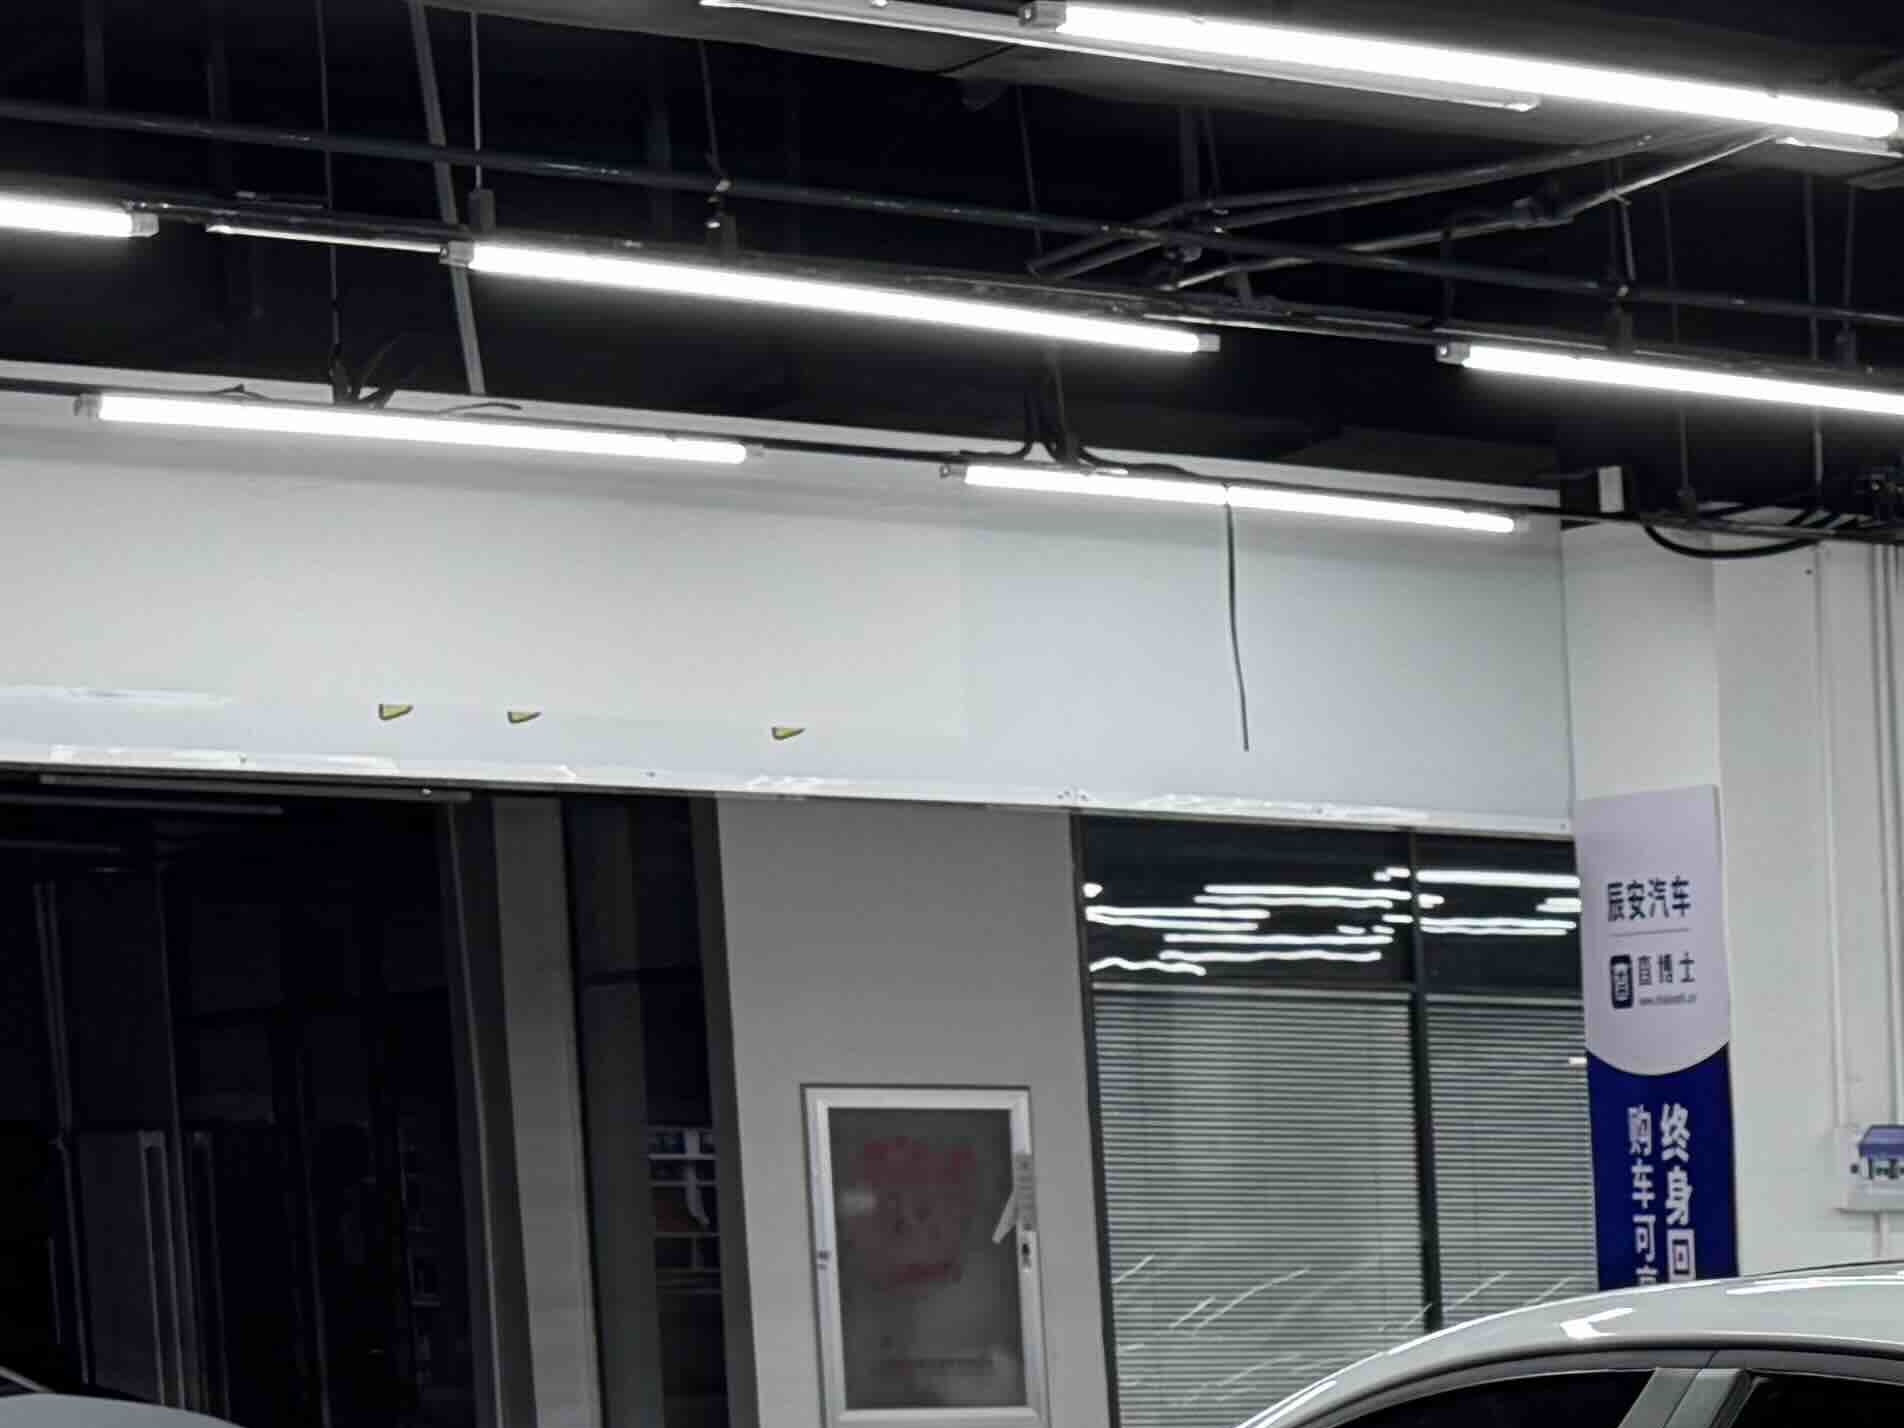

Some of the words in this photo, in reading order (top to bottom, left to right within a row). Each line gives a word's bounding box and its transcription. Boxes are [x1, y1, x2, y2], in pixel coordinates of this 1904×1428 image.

[1607, 875, 1691, 922] 辰安汽车
[1660, 1103, 1697, 1282] 终身回
